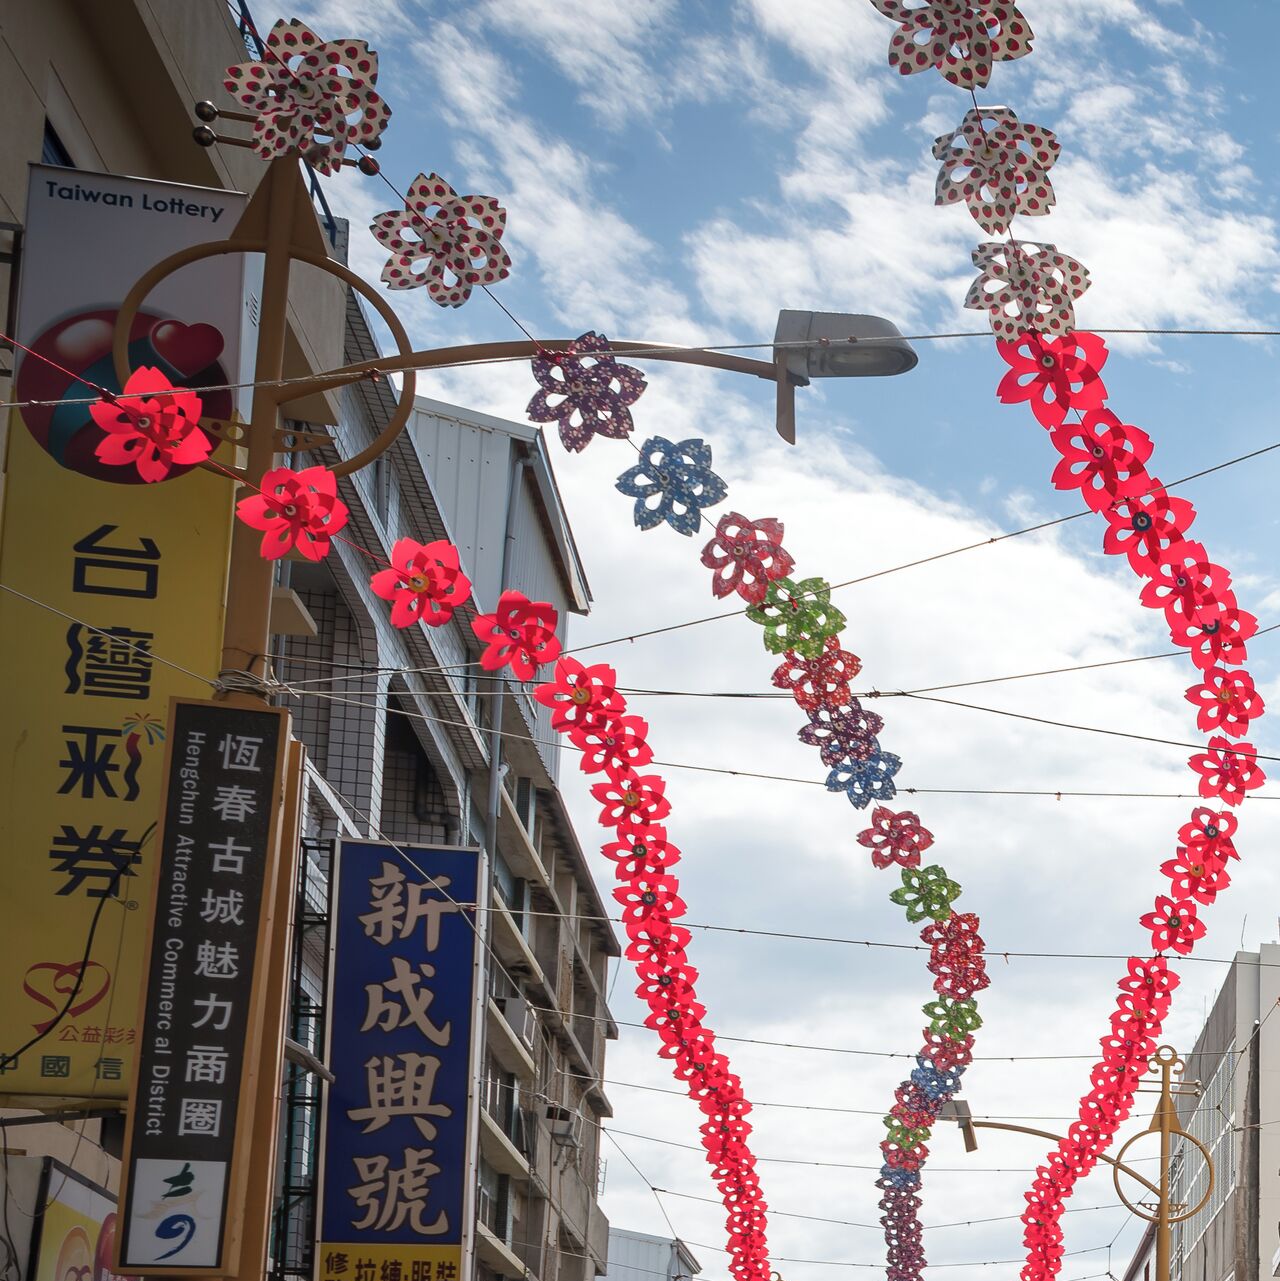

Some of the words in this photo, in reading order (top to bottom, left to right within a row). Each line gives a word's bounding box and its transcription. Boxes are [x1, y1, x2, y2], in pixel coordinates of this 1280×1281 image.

[46, 181, 134, 208] Taiwan
[142, 192, 225, 223] Lottery
[49, 523, 162, 898] 台灣彩券
[177, 731, 206, 826] Hengchun
[167, 833, 194, 929] Attractive
[177, 732, 265, 1138] 恆春古城魅力商圈
[153, 937, 184, 1055] Commercal
[347, 860, 461, 1237] 新成興號
[145, 1065, 170, 1137] District
